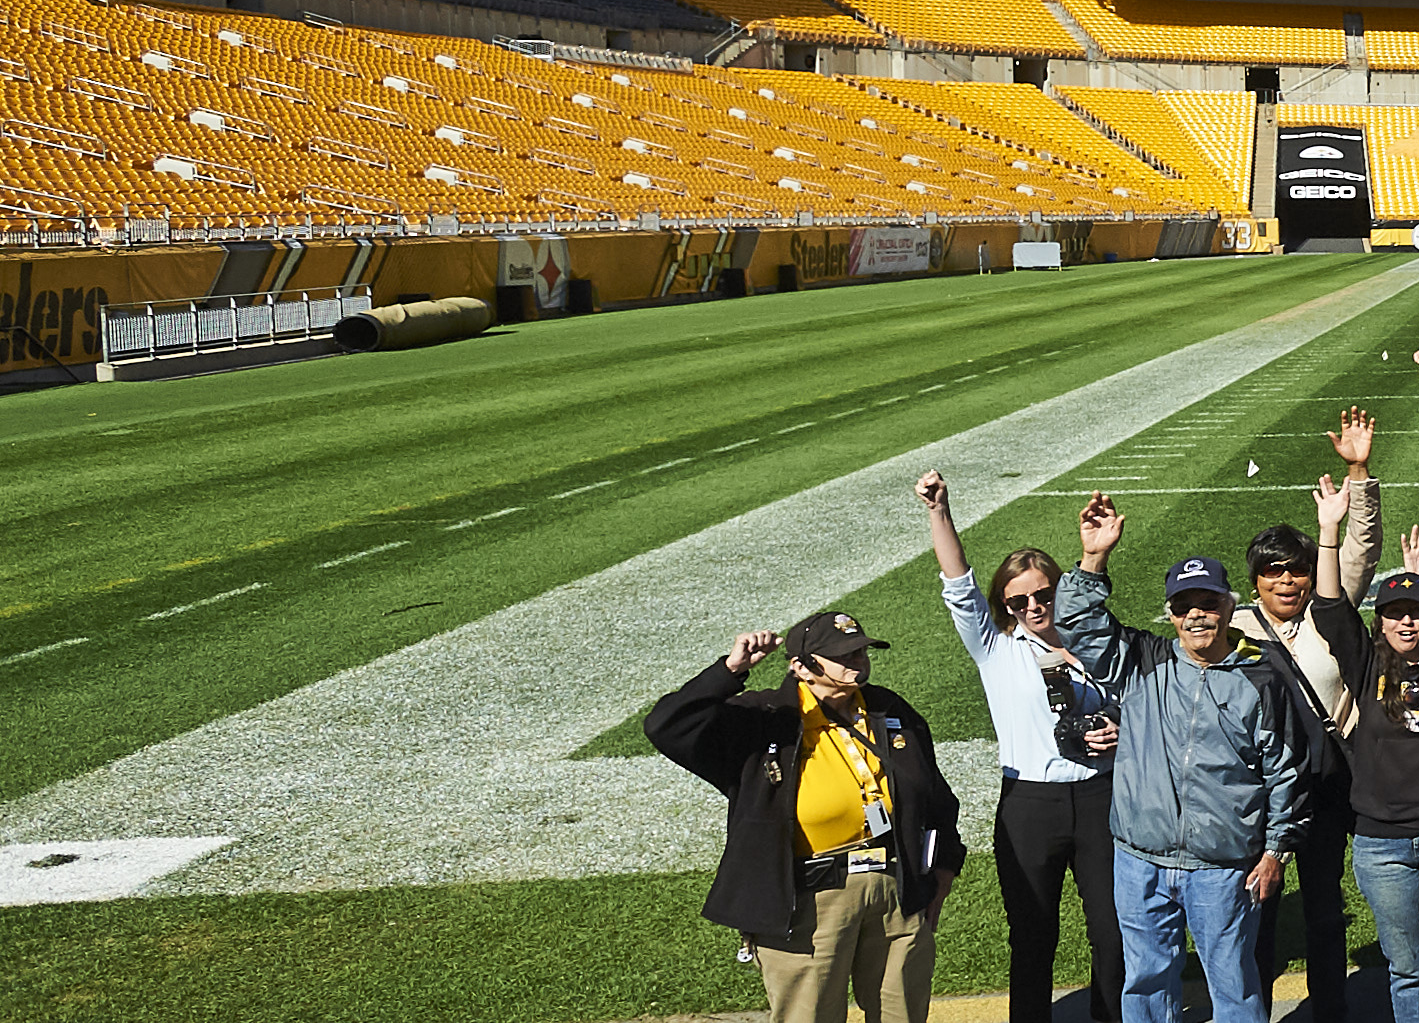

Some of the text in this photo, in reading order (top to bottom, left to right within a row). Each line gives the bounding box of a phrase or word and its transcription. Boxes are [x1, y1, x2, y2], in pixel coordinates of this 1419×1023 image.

[1278, 168, 1366, 182] GEICO
[1289, 185, 1357, 199] GEICO
[1221, 221, 1252, 249] 33
